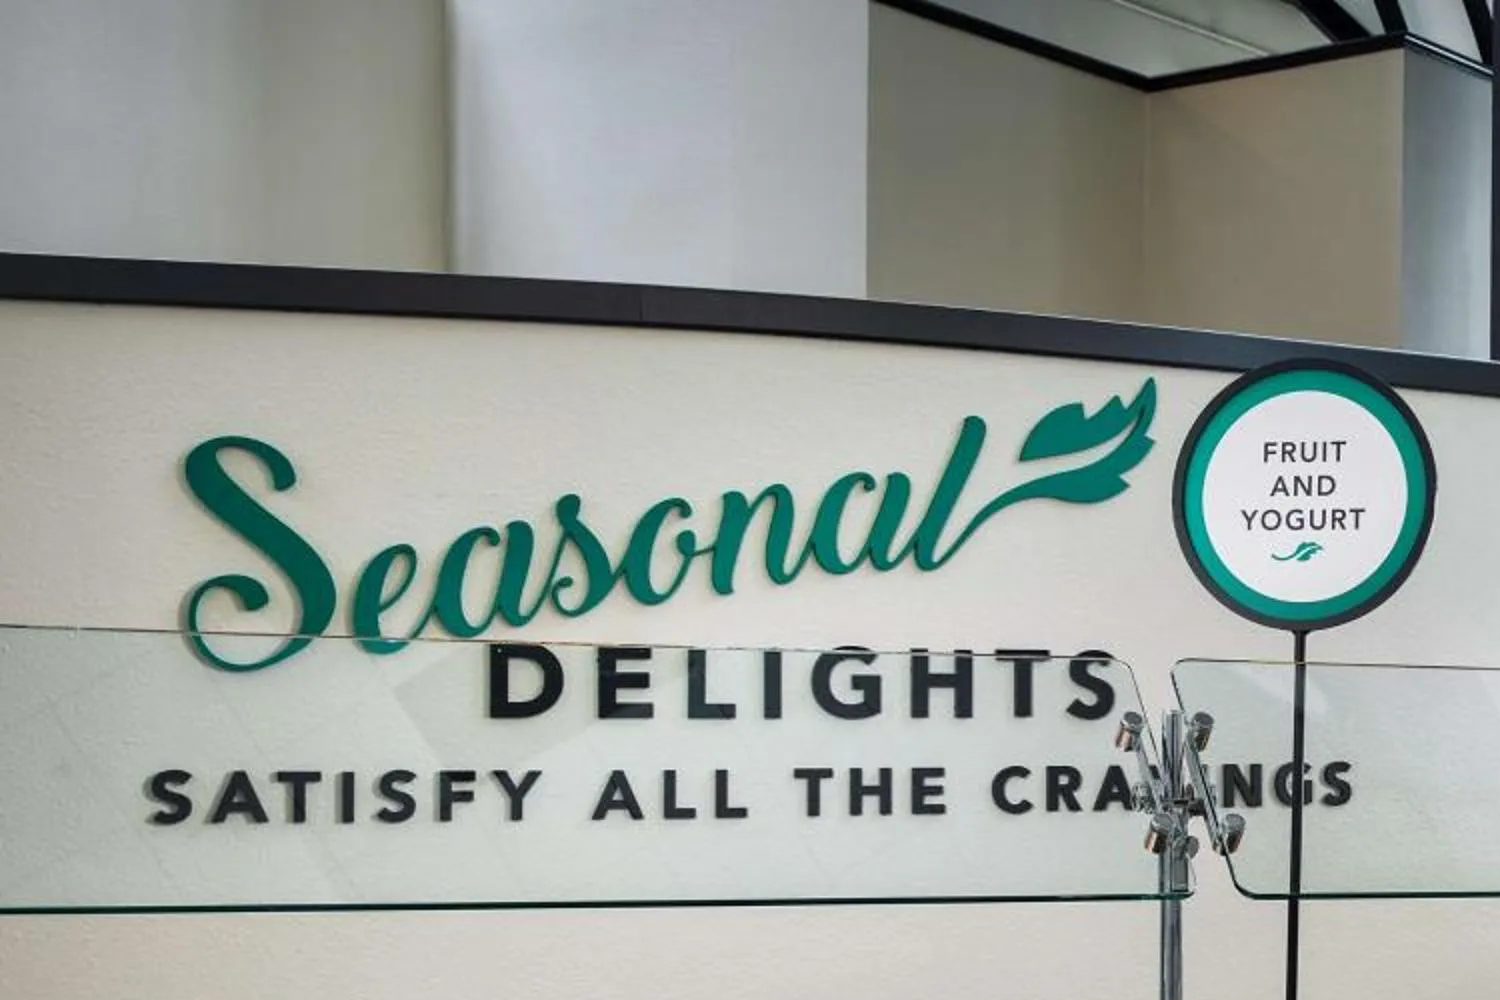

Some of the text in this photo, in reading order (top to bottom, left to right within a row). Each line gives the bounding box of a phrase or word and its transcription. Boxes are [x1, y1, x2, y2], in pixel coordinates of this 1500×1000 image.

[1263, 441, 1347, 463] FRUIT
[1269, 475, 1337, 497] AND
[1241, 508, 1366, 531] YOGURT
[185, 414, 985, 671] Seasonal
[488, 643, 1117, 722] DELIGHTS
[148, 761, 1353, 827] SATISFY ALL THE CRANGS
